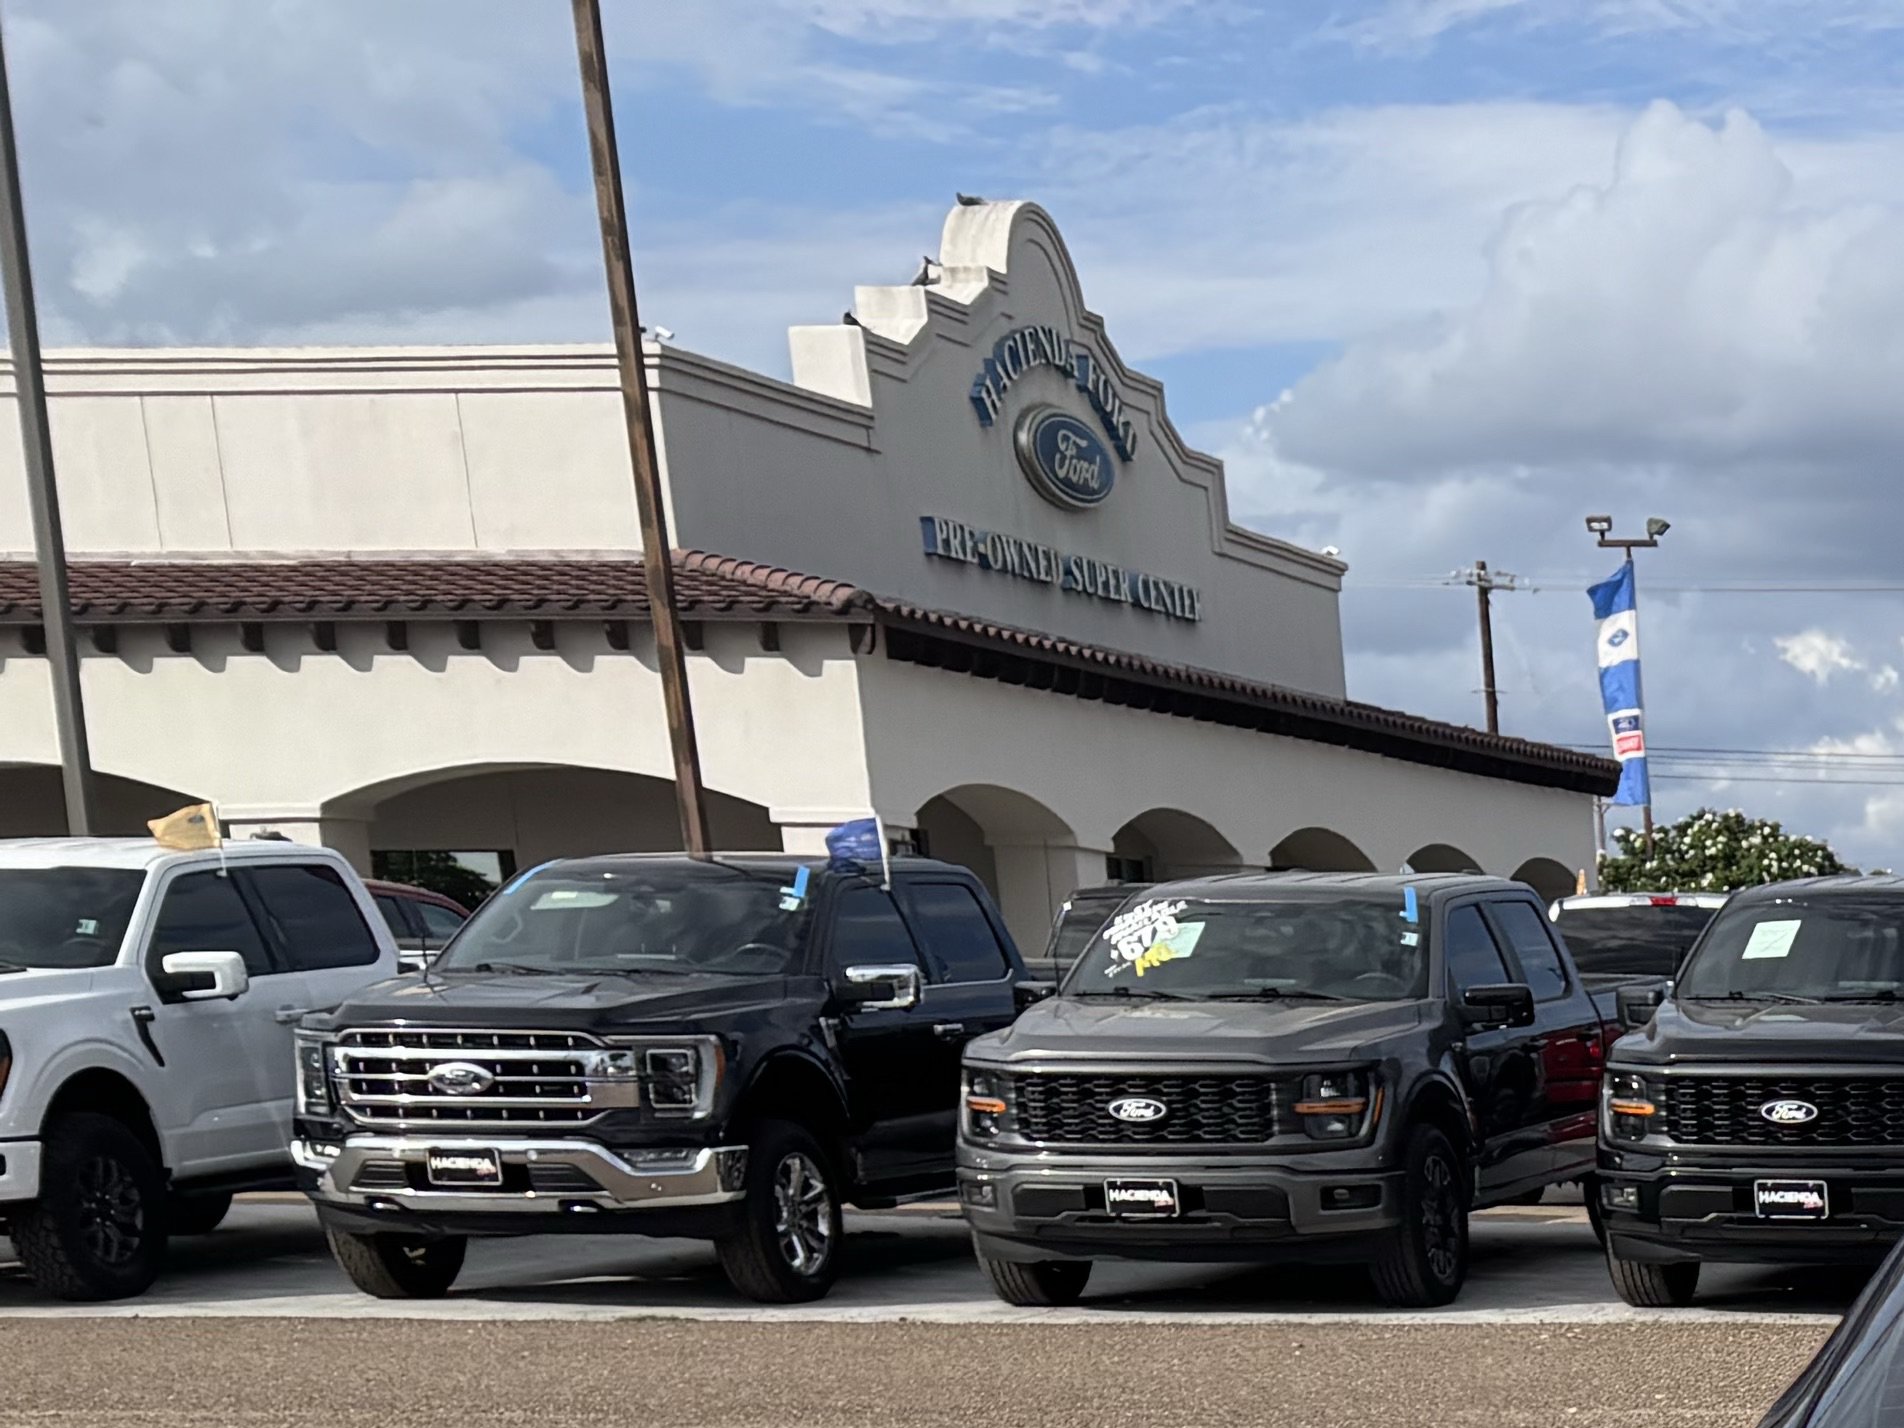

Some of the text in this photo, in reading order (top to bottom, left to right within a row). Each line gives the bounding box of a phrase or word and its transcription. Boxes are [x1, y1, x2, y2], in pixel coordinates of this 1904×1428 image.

[976, 325, 1080, 424] HACIENDA
[1054, 428, 1101, 490] Ford
[932, 517, 1064, 585] PRE-OWNED
[1068, 555, 1132, 603] SUPER
